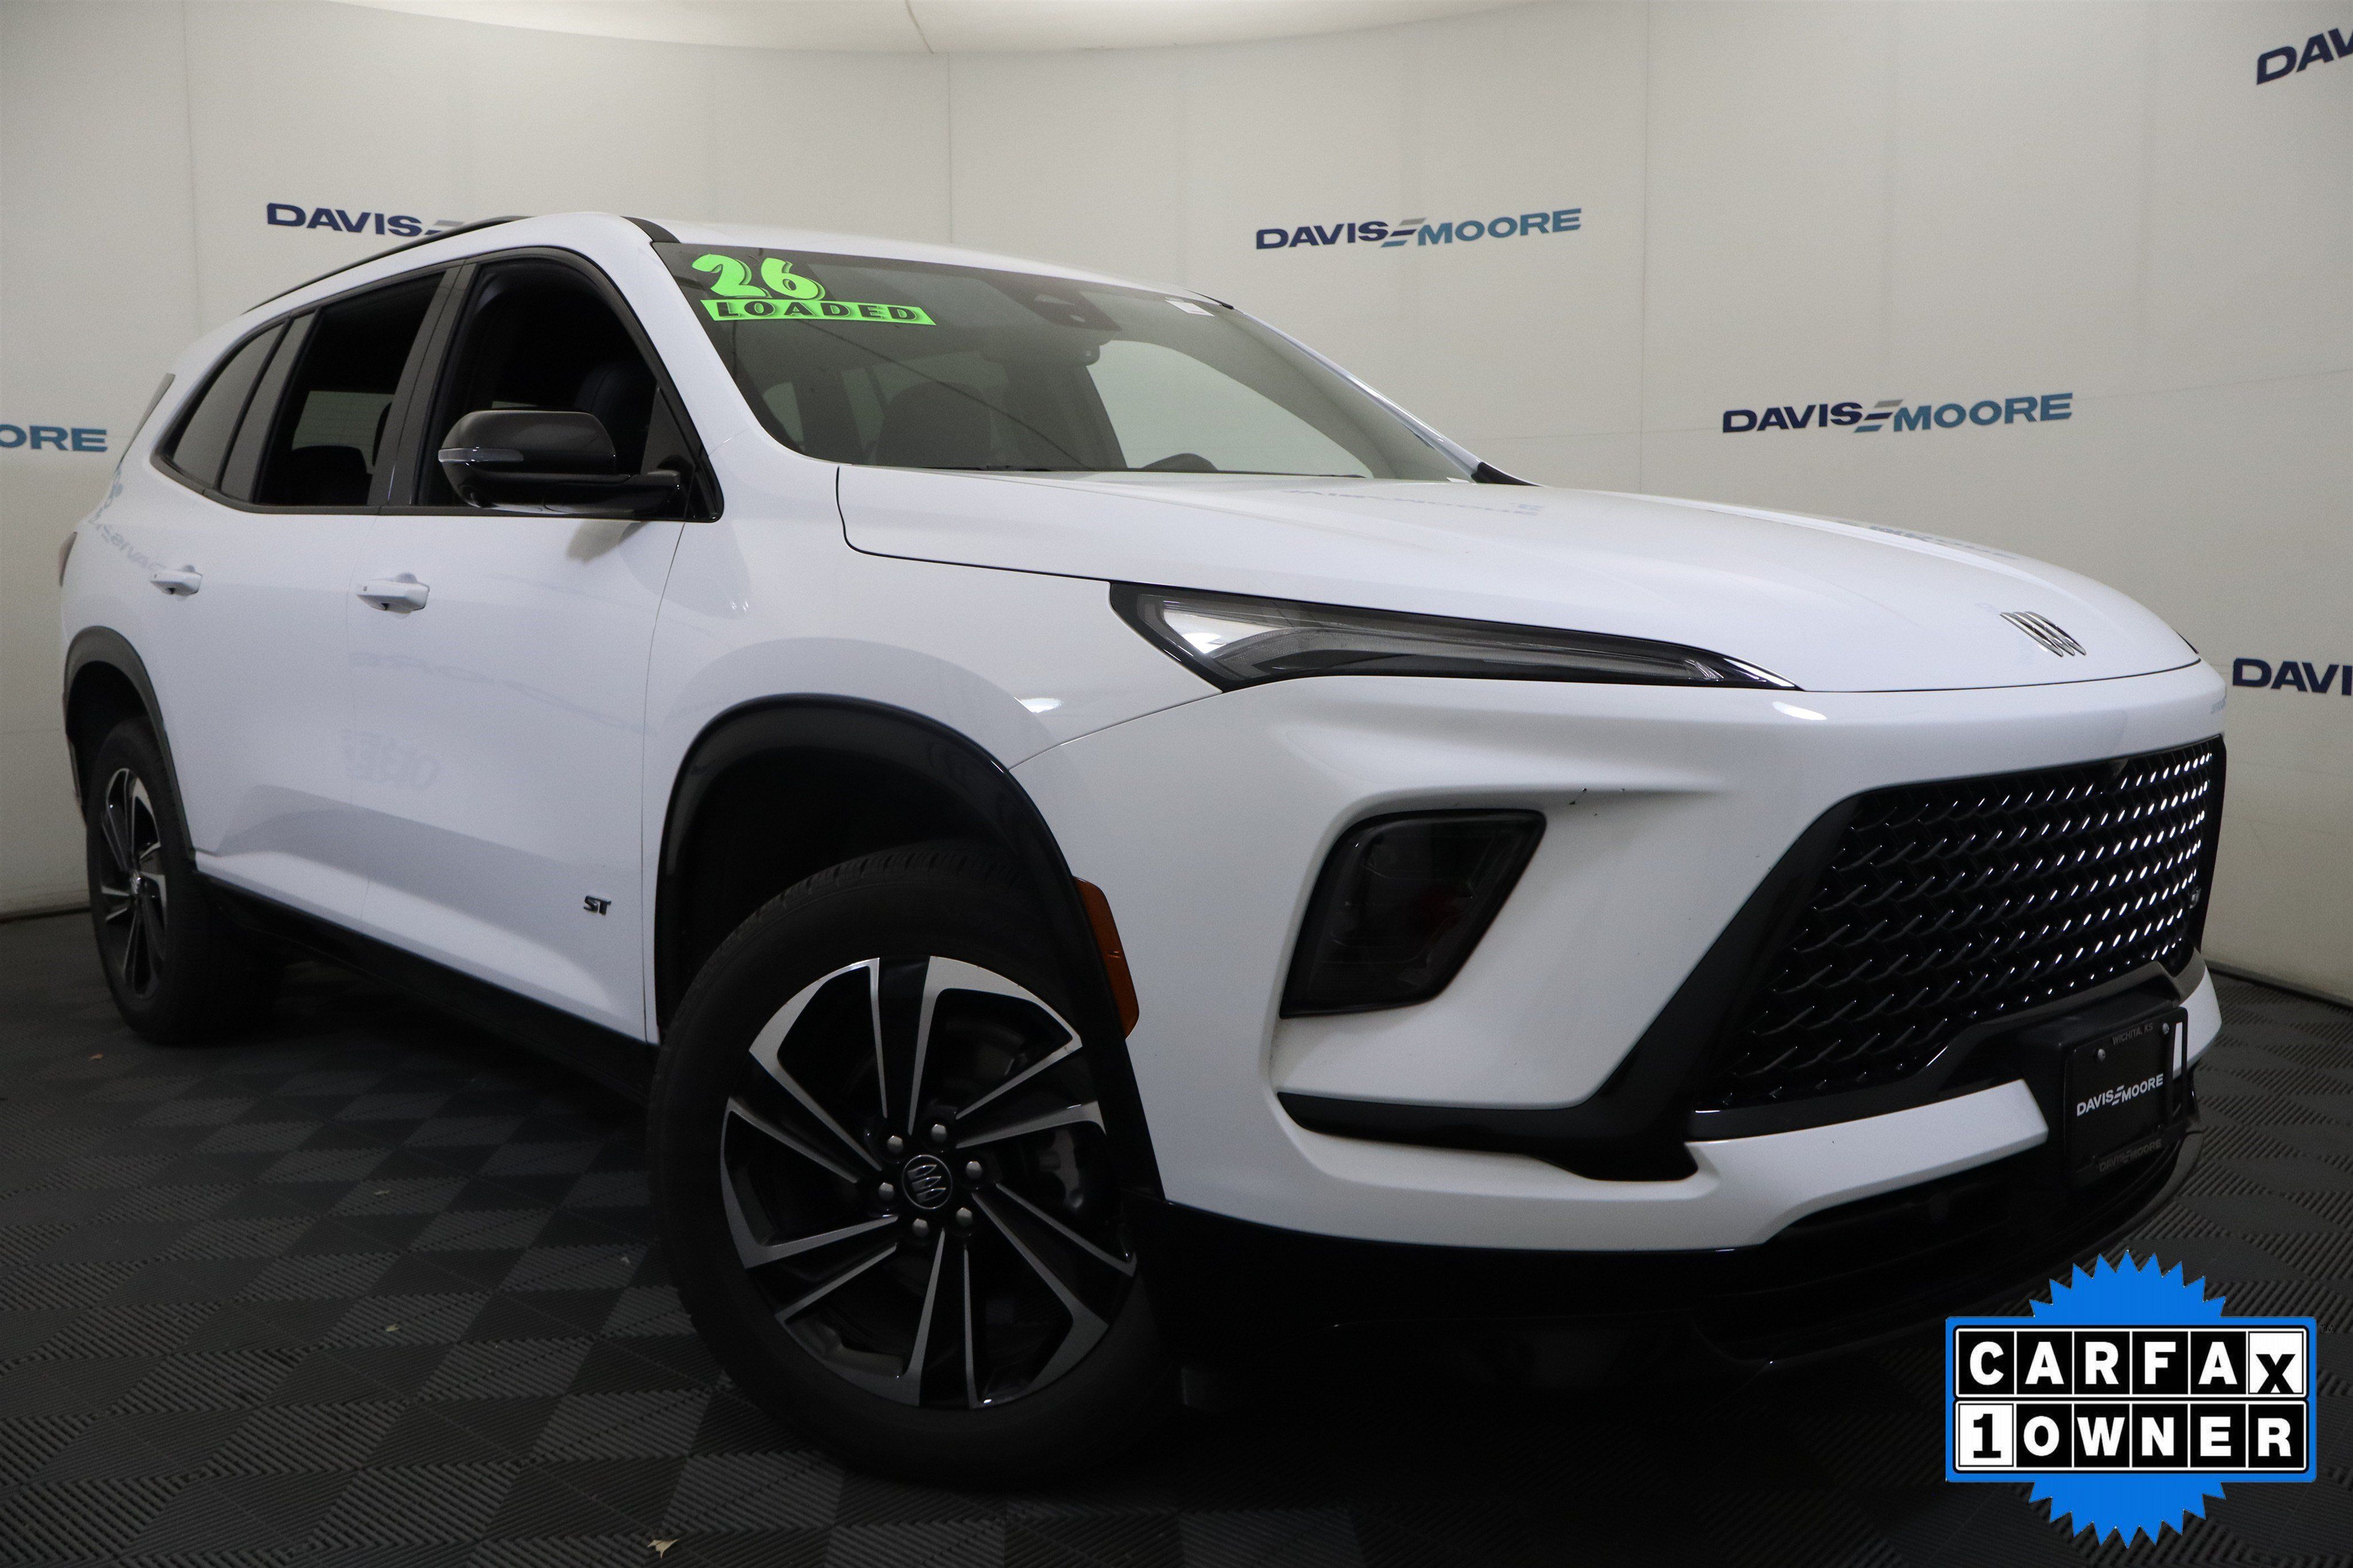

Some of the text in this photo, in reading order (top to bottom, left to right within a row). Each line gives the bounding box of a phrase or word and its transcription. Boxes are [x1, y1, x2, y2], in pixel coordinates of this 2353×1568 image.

[267, 202, 423, 237] DAVIS
[1256, 208, 1582, 249] DAVIS MOORE
[692, 253, 826, 300] 26
[716, 300, 917, 320] LOADED
[1722, 392, 2073, 432] DAVIS MOORE
[583, 895, 612, 916] ST
[2077, 1073, 2164, 1116] DAVIS MOORE
